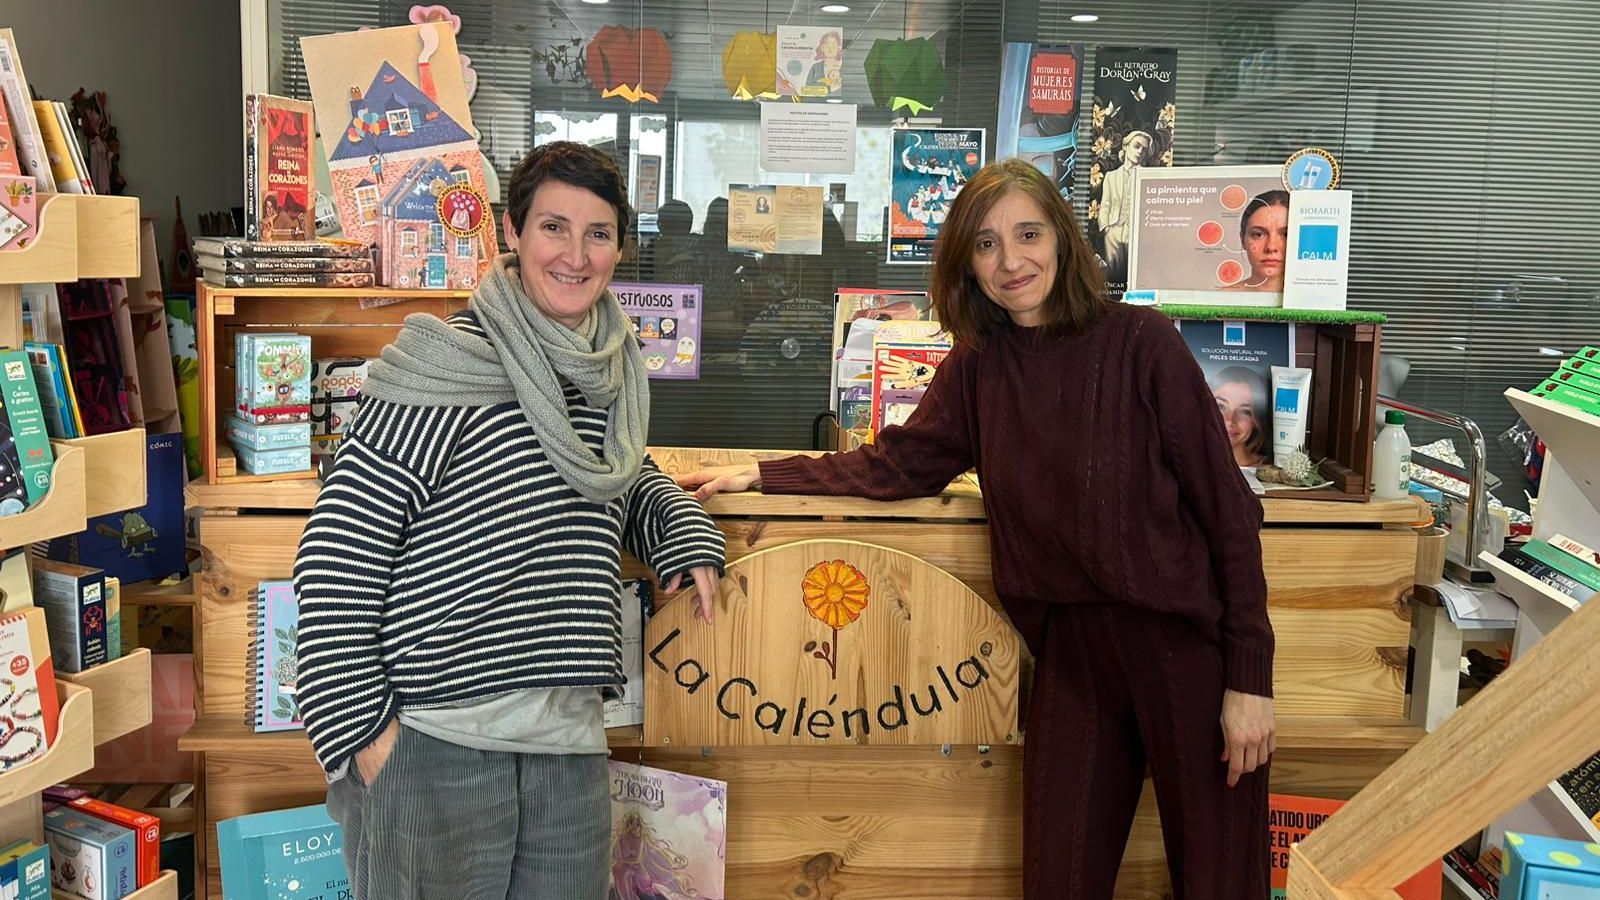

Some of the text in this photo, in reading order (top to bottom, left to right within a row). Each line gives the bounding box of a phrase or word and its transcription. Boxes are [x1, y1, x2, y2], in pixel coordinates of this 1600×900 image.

[1036, 66, 1062, 74] HISTORIAS
[1114, 61, 1123, 69] EL
[1033, 75, 1073, 88] MUJERES
[959, 134, 968, 142] 17
[277, 159, 300, 172] REINA
[268, 173, 308, 185] CORAZONES
[1146, 186, 1217, 196] La pimienta que
[1186, 196, 1204, 206] piel
[1301, 250, 1334, 261] CALM
[1276, 405, 1296, 413] CALM
[272, 433, 293, 441] PUZZLE
[150, 440, 173, 450] CÓMIC
[649, 628, 990, 739] La Caléndula
[283, 833, 334, 857] ELOY
[326, 880, 336, 890] El
